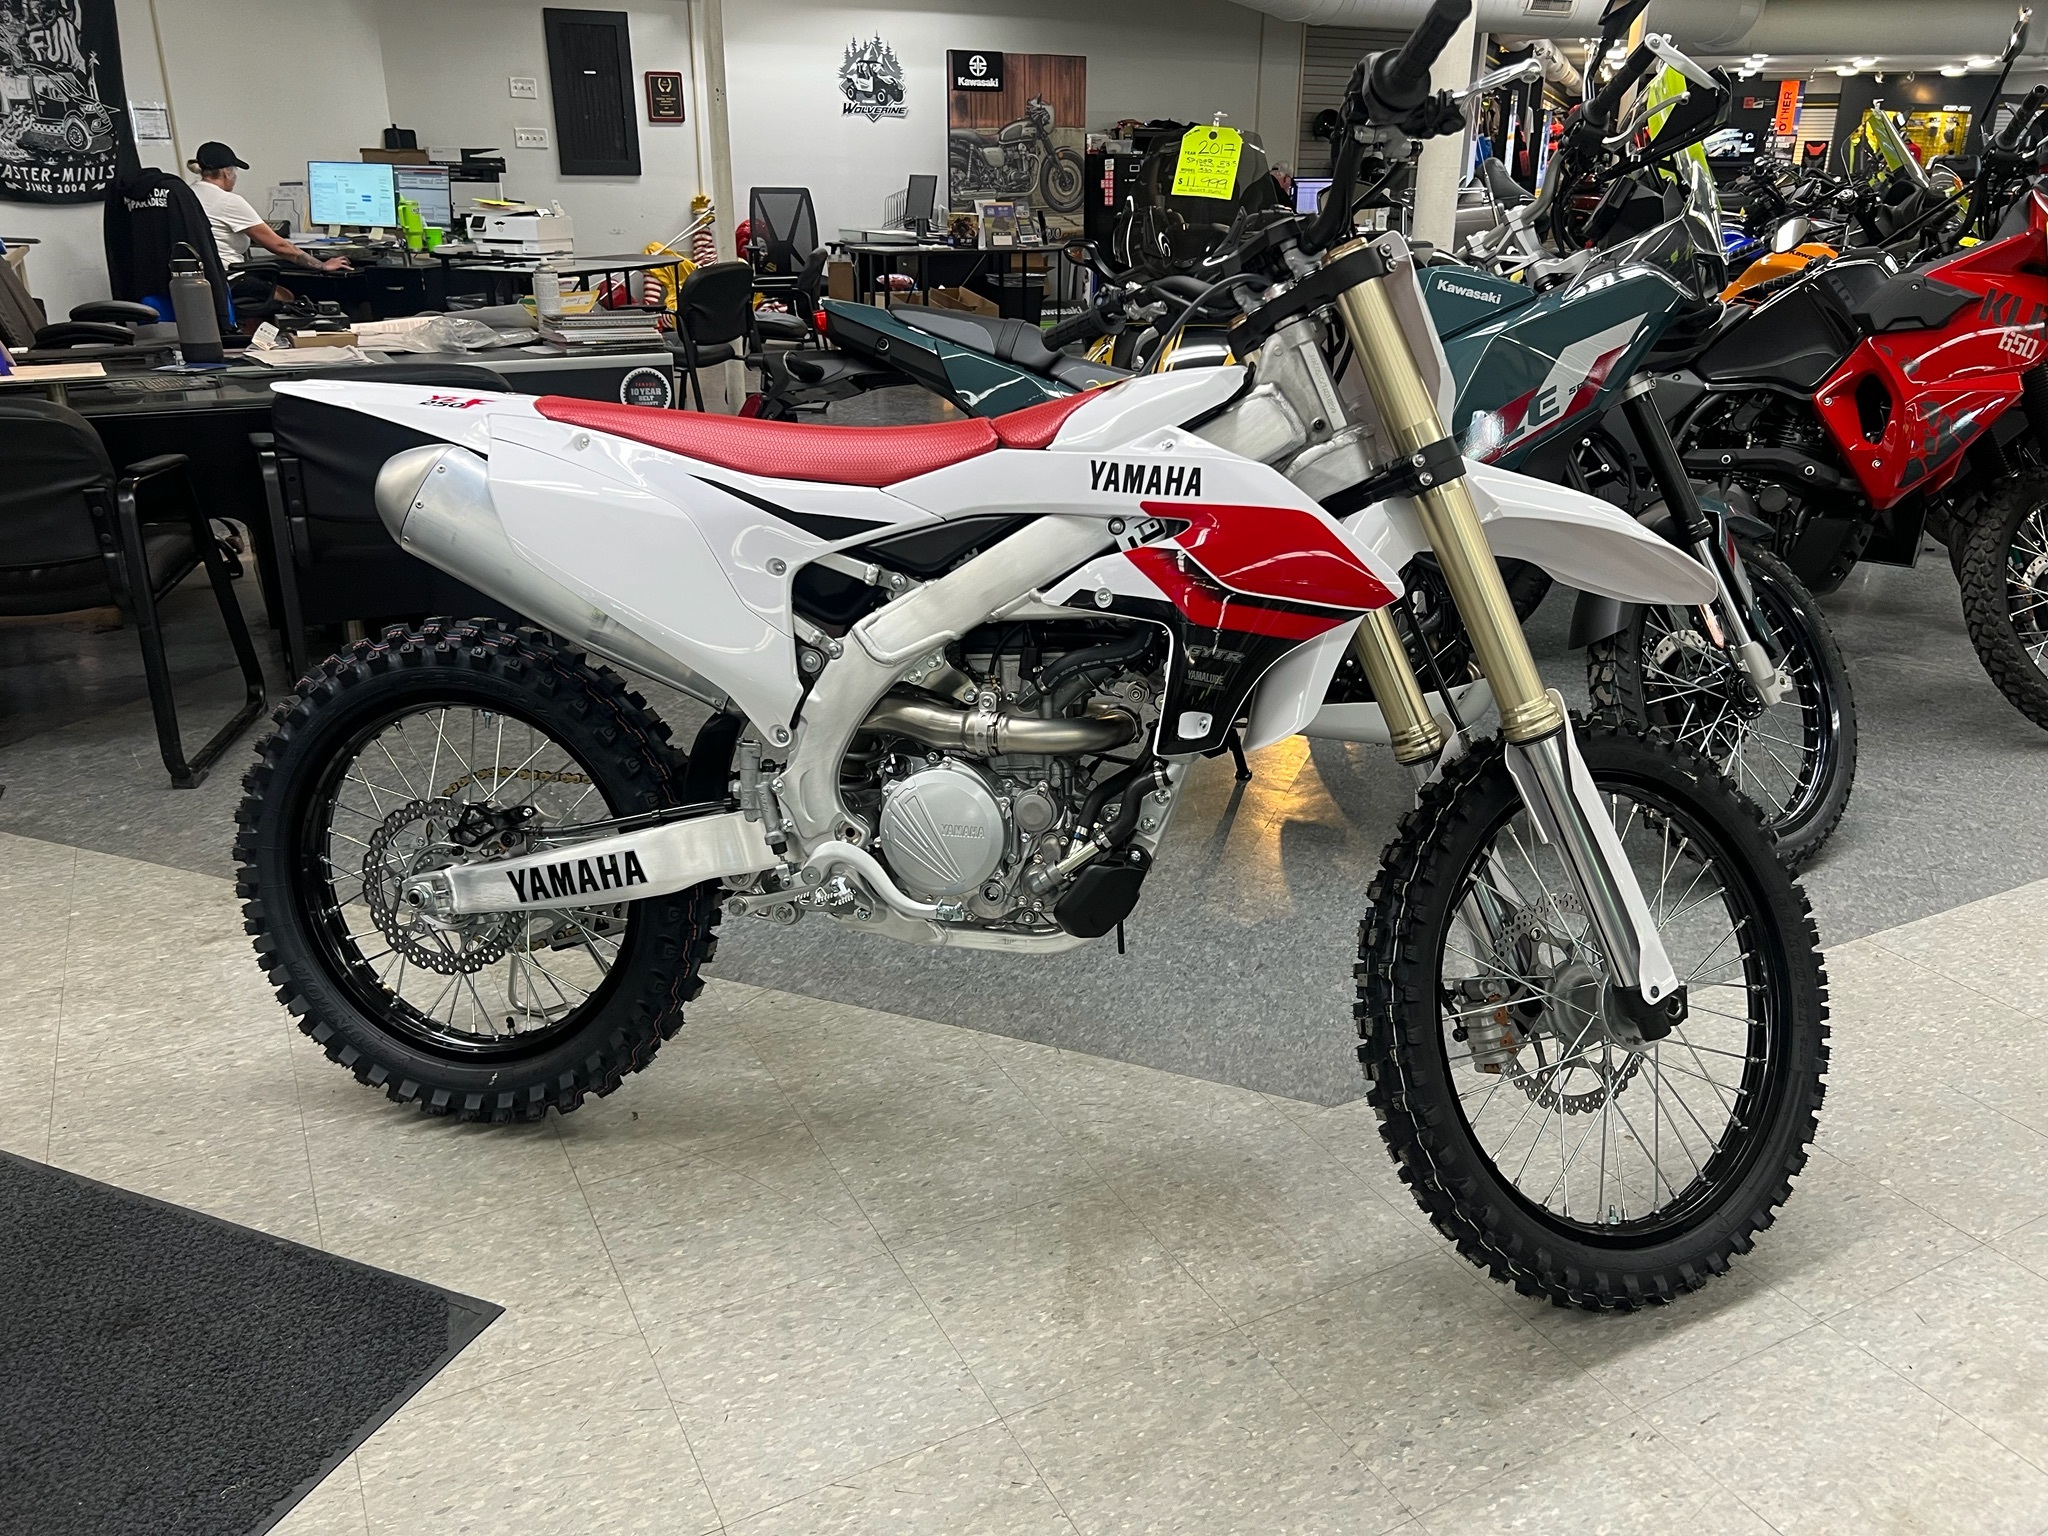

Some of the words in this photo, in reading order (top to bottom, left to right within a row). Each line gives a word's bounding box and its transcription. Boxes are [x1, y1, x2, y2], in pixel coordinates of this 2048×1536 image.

[28, 17, 87, 74] FUN
[957, 76, 999, 87] Kawasaki
[1198, 140, 1236, 156] 2017
[0, 164, 116, 183] ASTER-MINIS
[25, 182, 53, 193] SINCE
[57, 183, 86, 193] 2004
[154, 188, 169, 198] DAY
[1437, 279, 1501, 304] Kawasaki
[1998, 329, 2039, 359] 650
[640, 387, 662, 395] YEAR
[1090, 460, 1202, 497] YAMAHA
[1187, 644, 1246, 664] GYTR
[1187, 669, 1225, 686] YAMALUBE
[941, 823, 986, 839] YAMAHA
[506, 850, 649, 903] YAMAHA
